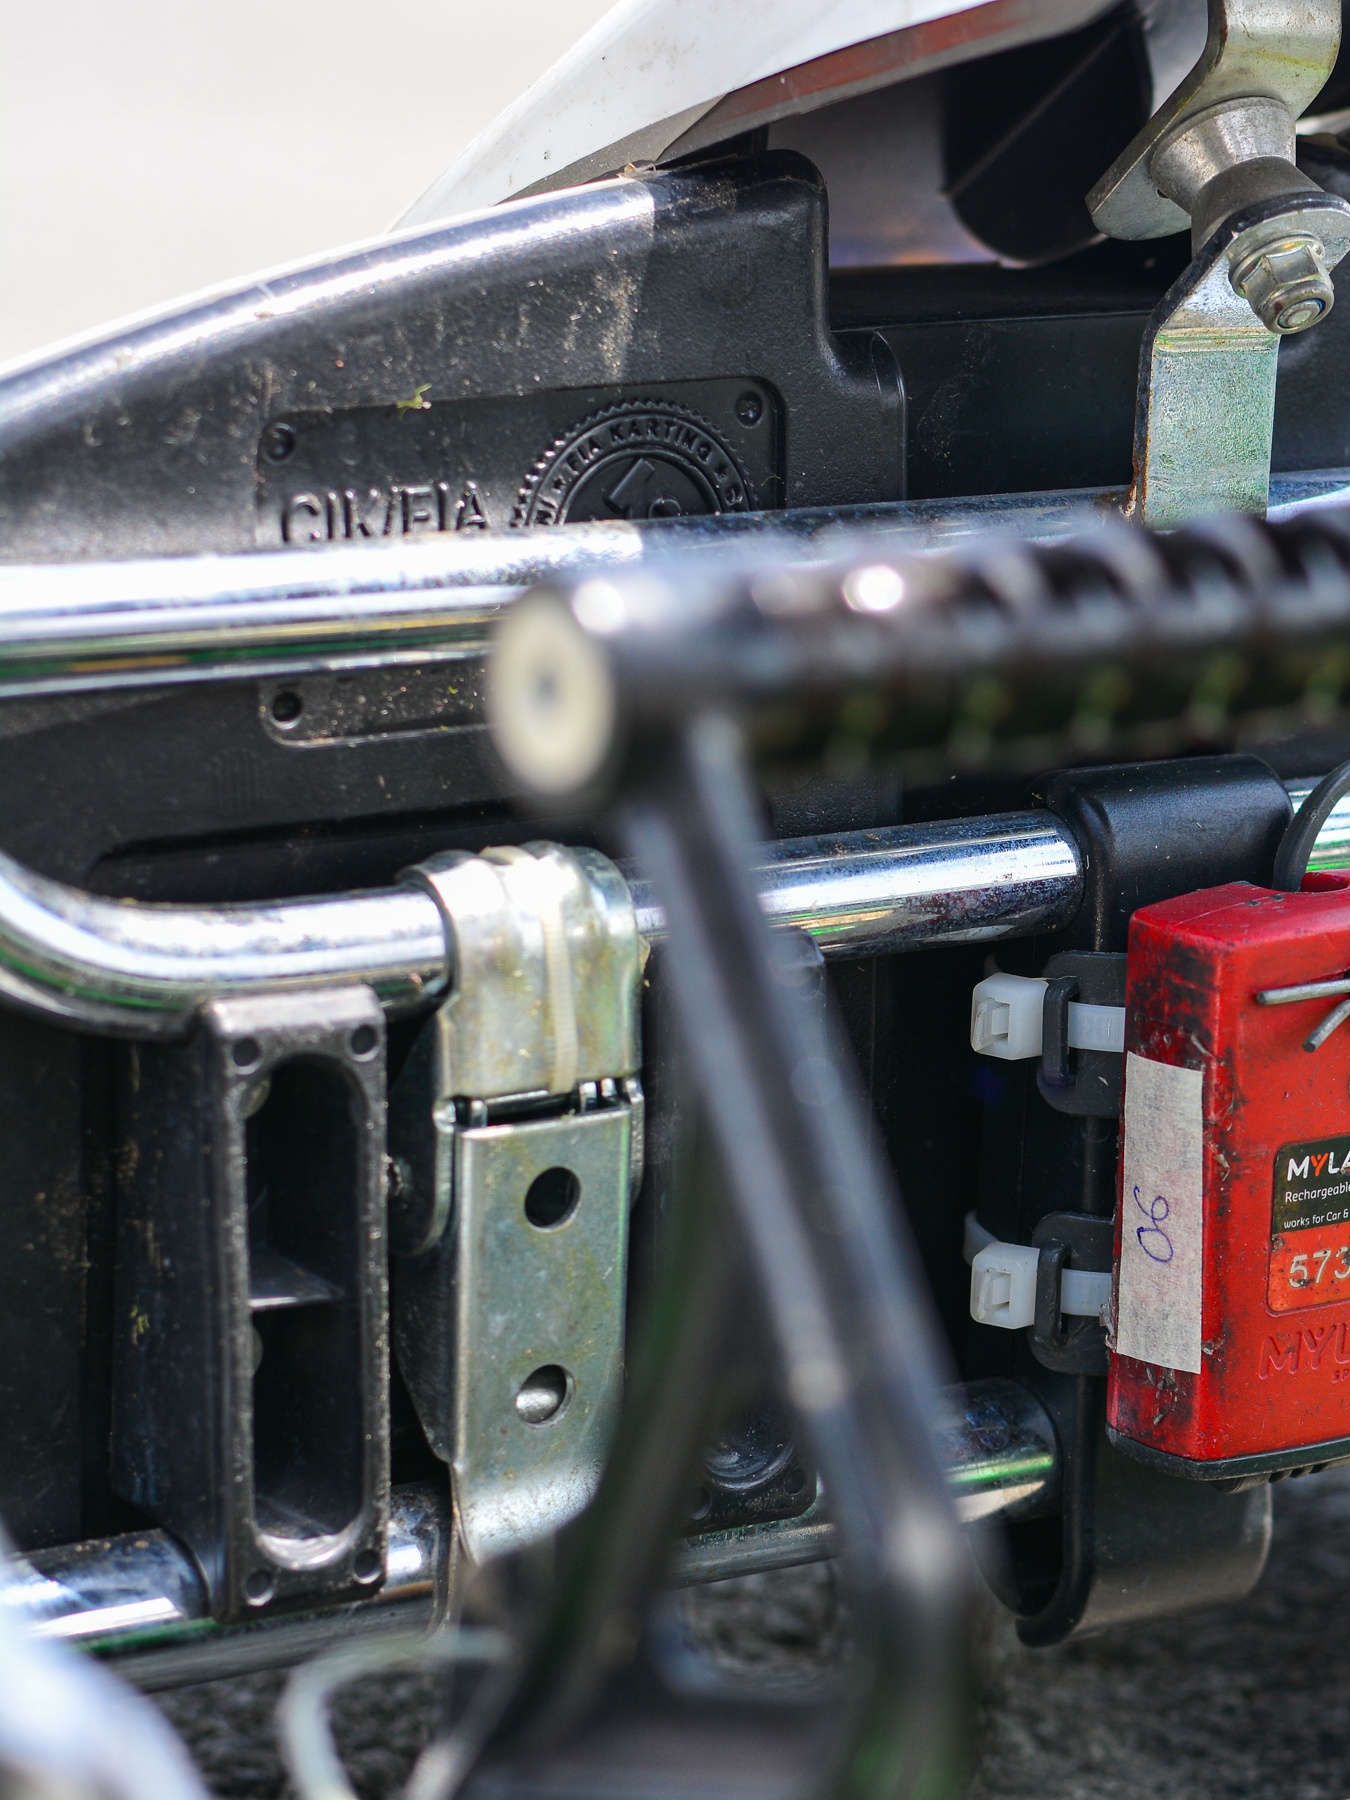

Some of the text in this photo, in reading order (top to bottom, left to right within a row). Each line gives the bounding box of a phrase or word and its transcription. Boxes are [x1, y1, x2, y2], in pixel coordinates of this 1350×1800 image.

[282, 481, 490, 541] CIK/FIA
[1283, 1217, 1310, 1229] works
[1312, 1213, 1325, 1224] for
[1327, 1211, 1340, 1222] Car
[1343, 1208, 1349, 1218] &
